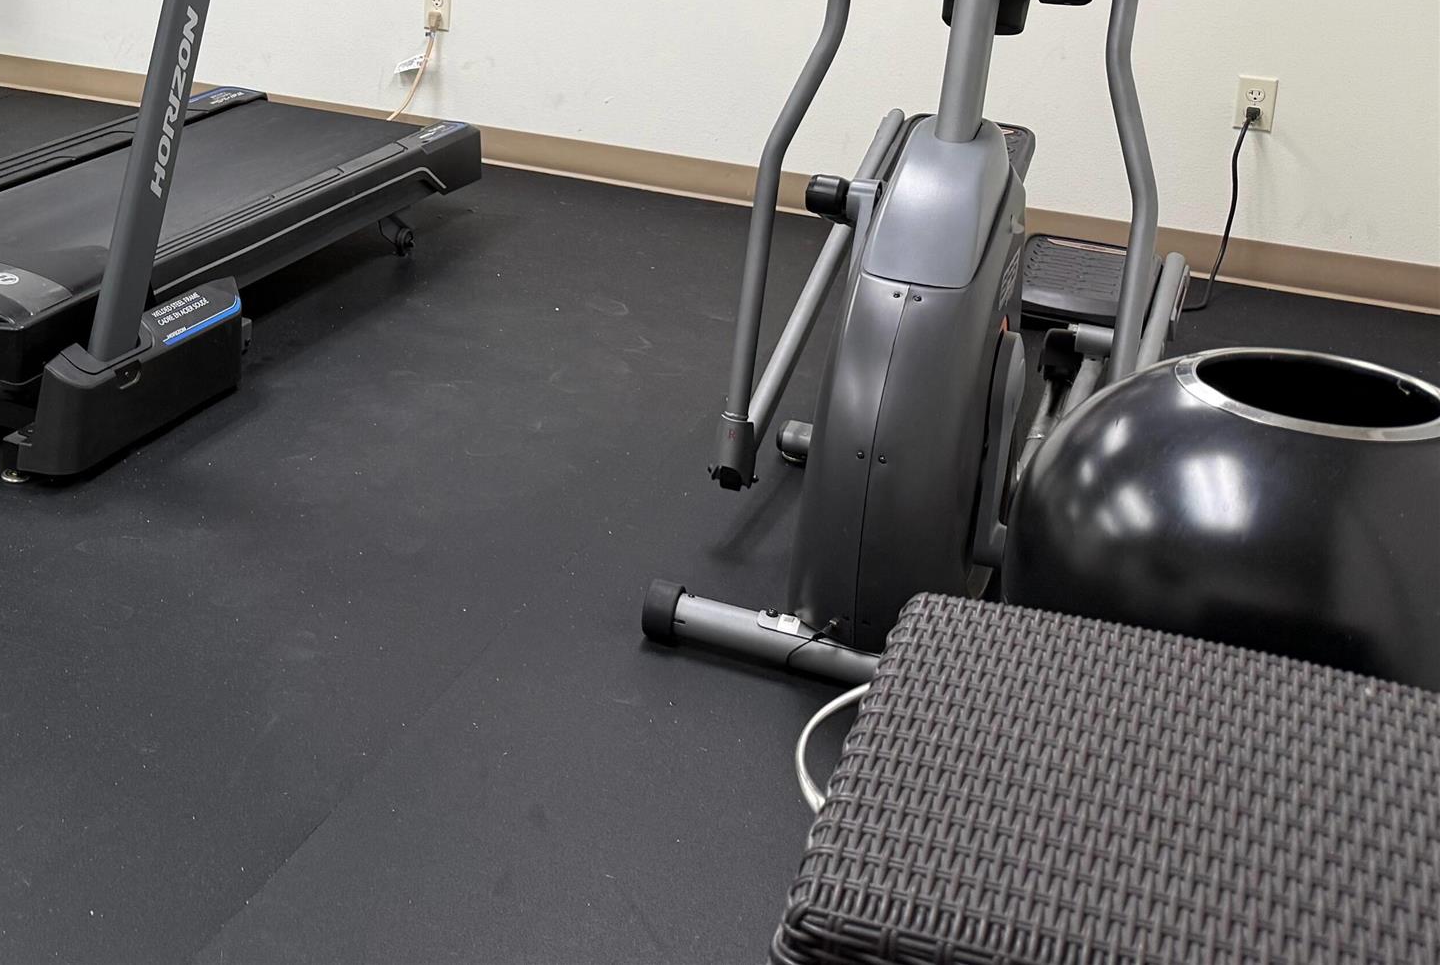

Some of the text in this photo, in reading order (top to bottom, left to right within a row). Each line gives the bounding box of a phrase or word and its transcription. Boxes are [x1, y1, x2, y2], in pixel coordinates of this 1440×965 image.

[150, 5, 199, 199] HORIZON
[152, 292, 201, 318] WELDED STEEL FRAME
[157, 313, 175, 326] CADRE
[180, 304, 195, 316] ACIER
